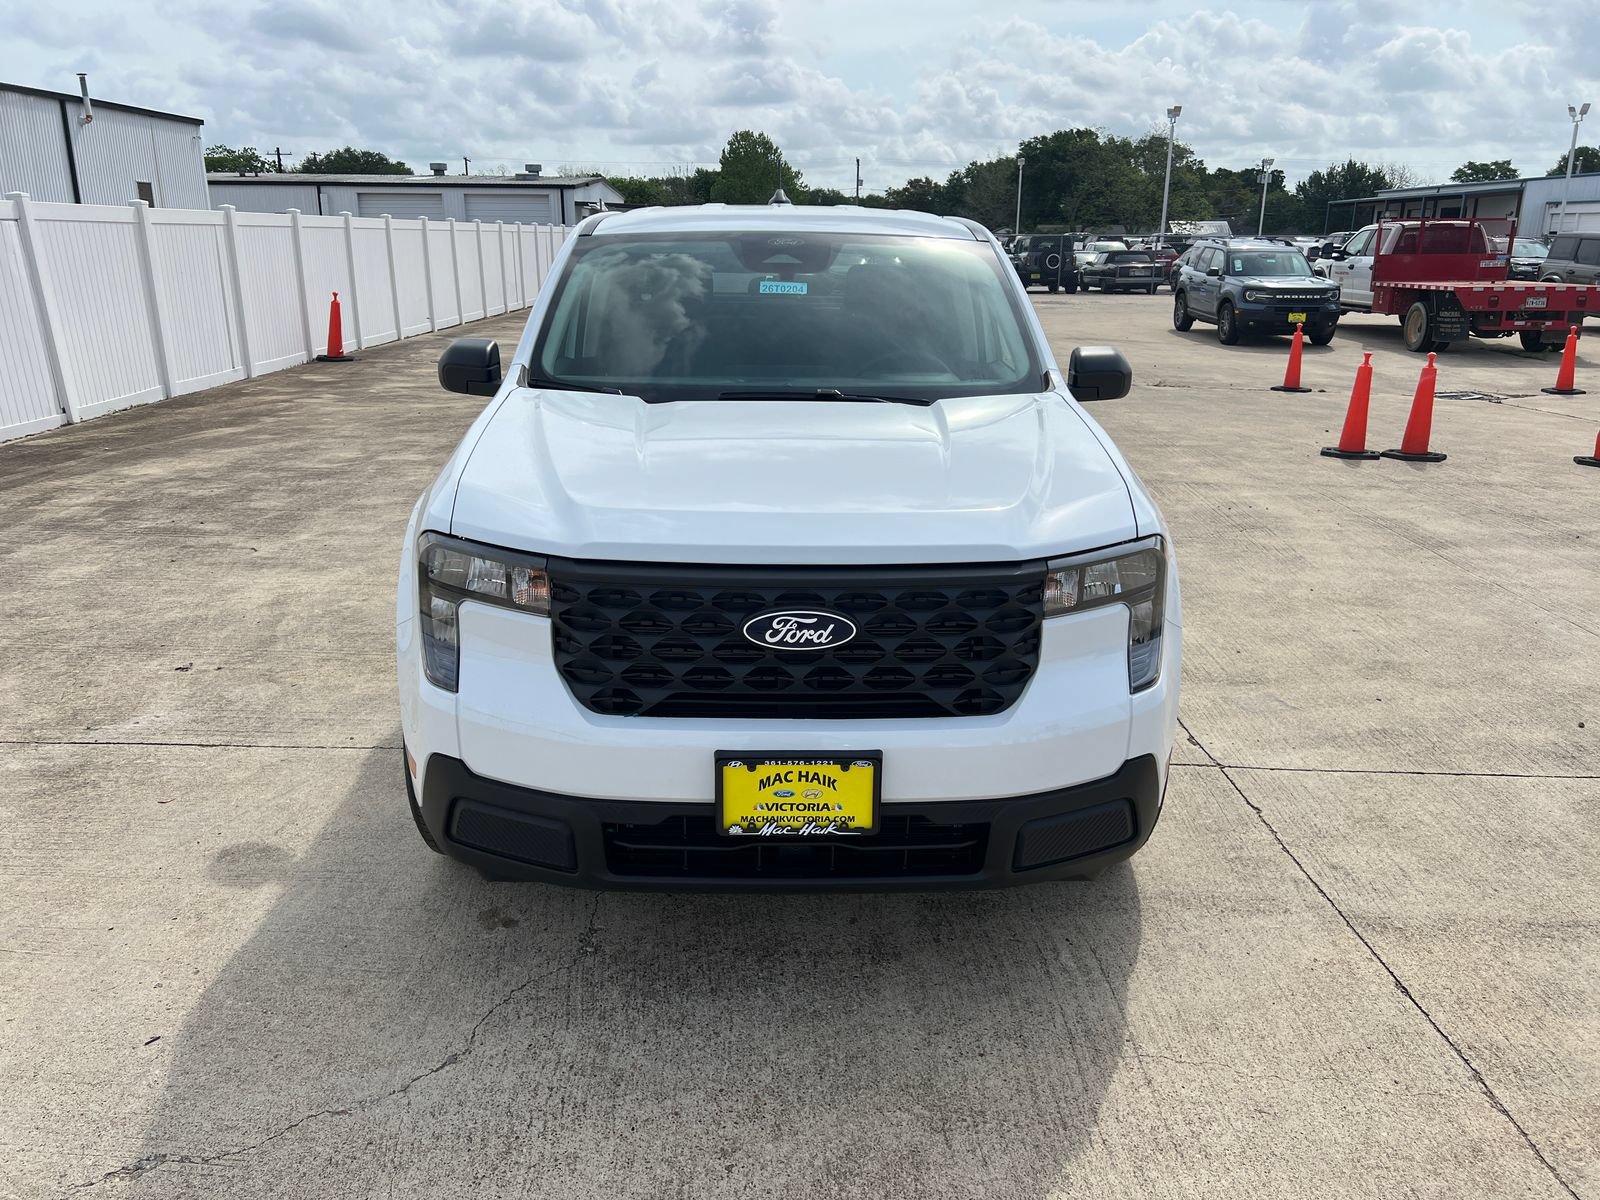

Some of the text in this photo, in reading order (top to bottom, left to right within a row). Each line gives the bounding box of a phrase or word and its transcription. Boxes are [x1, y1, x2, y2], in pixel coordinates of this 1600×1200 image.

[761, 284, 805, 293] 26T0204
[765, 616, 835, 643] Ford
[758, 771, 838, 791] MAC HAIK
[765, 802, 831, 812] VICTORIA
[740, 815, 856, 823] MACHAIKVICTORIA.COM
[758, 821, 838, 837] Mac Haik
